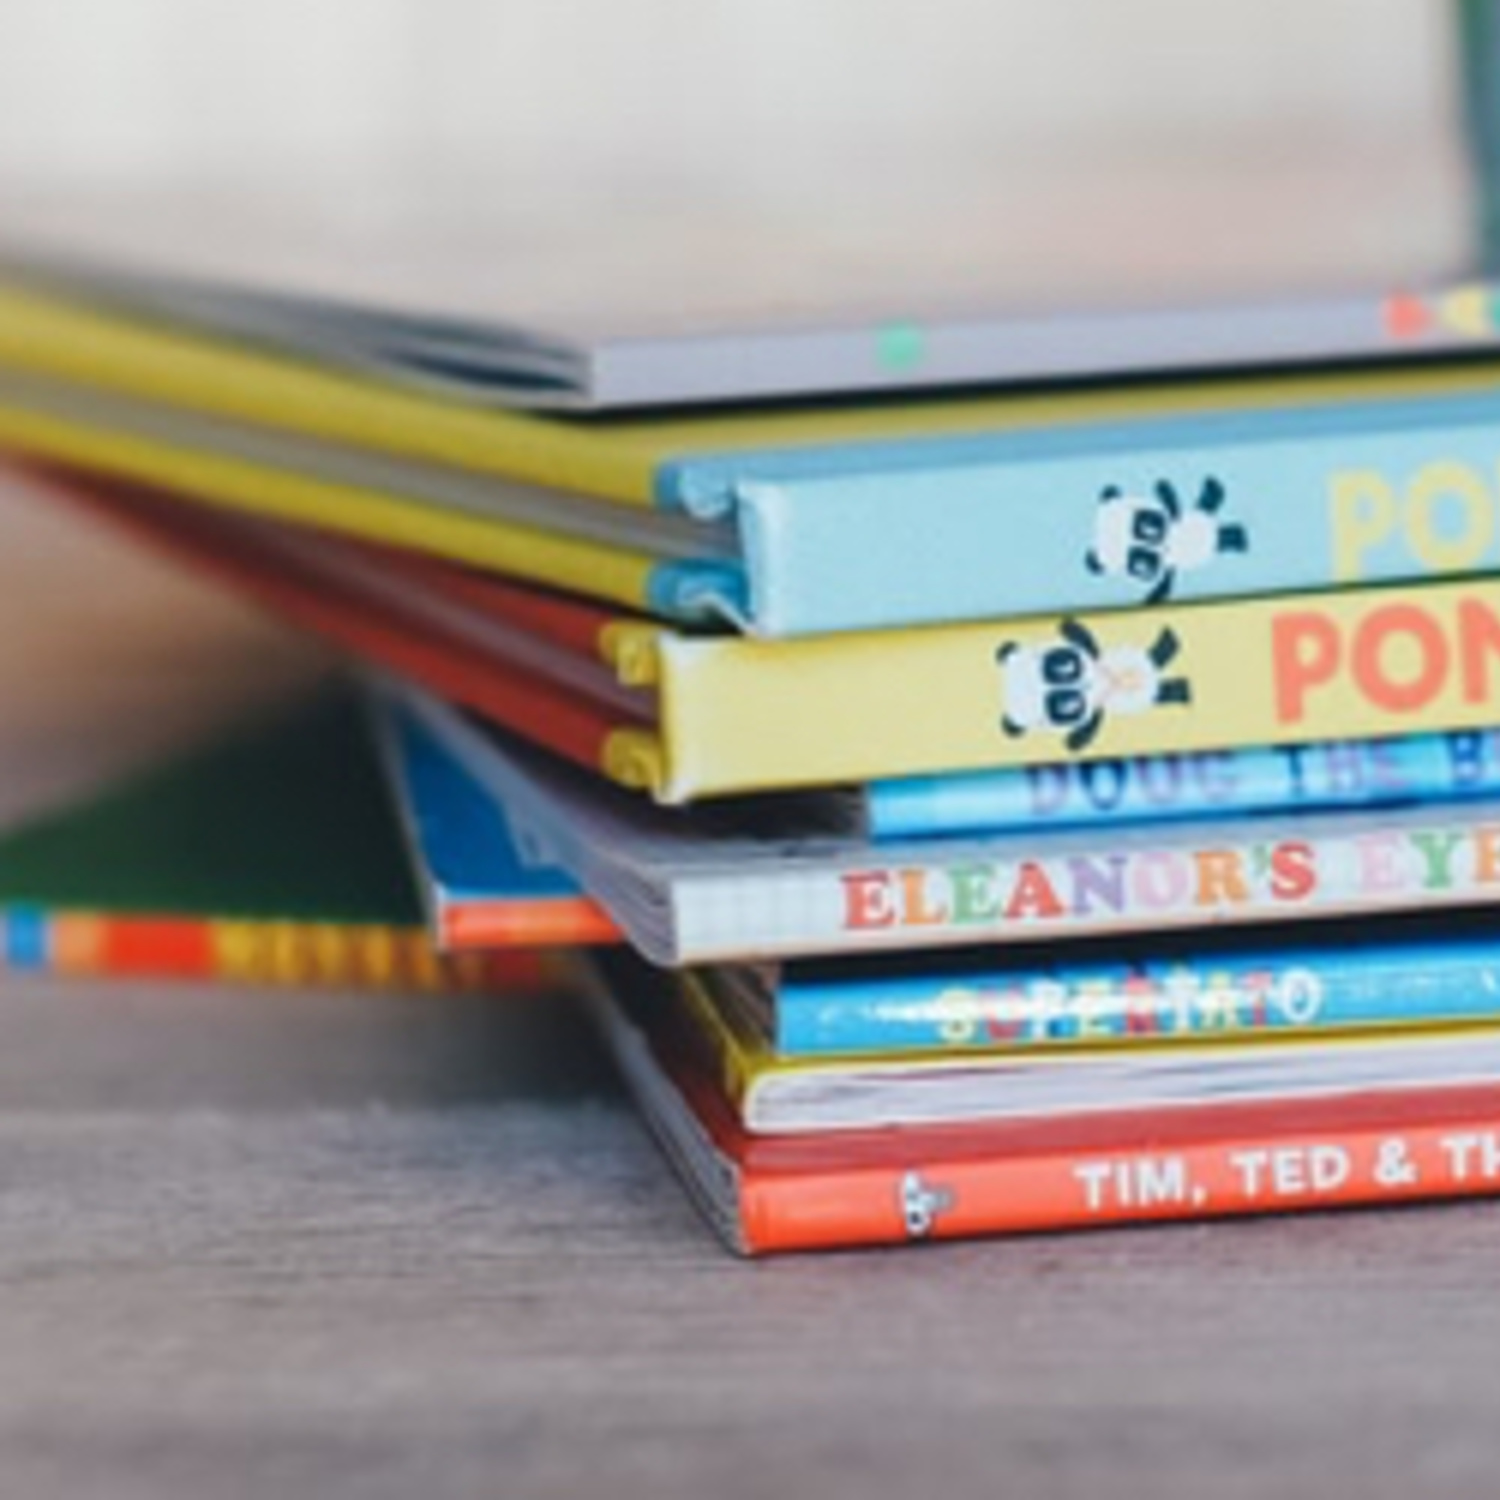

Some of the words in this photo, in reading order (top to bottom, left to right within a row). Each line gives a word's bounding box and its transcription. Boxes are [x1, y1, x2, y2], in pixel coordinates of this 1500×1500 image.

[839, 840, 1317, 930] ELEANOR'S
[1073, 1155, 1207, 1212] TIM,
[1230, 1143, 1351, 1197] TED
[1373, 1135, 1418, 1186] &
